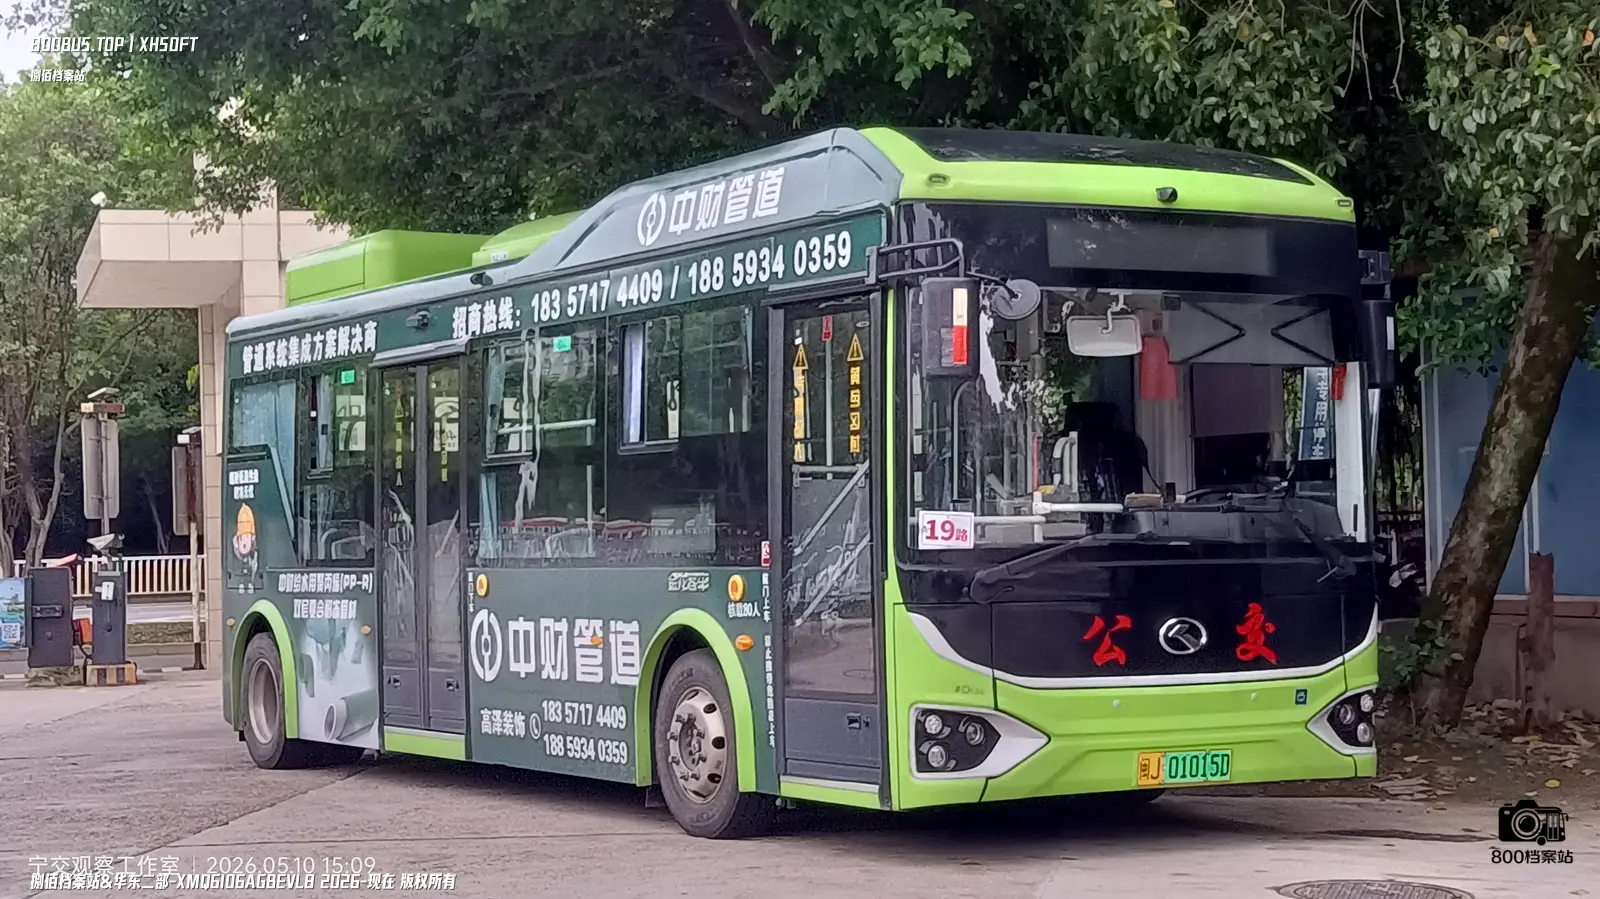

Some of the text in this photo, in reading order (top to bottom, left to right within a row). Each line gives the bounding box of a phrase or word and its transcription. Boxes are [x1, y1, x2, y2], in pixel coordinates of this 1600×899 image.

[668, 167, 786, 235] 中财管道
[531, 288, 561, 323] 183
[567, 279, 611, 317] 5717
[616, 268, 663, 308] 4409
[688, 256, 724, 295] 188
[732, 244, 785, 288] 5934
[793, 230, 852, 276] 0359
[242, 320, 378, 375] 管道系统集成方案解决商
[925, 519, 968, 542] 19路
[507, 616, 641, 686] 中财管道
[1082, 614, 1133, 667] 公
[479, 699, 627, 738] 高泽装饰 183 5717 4409
[543, 733, 628, 765] 188 5934 0359
